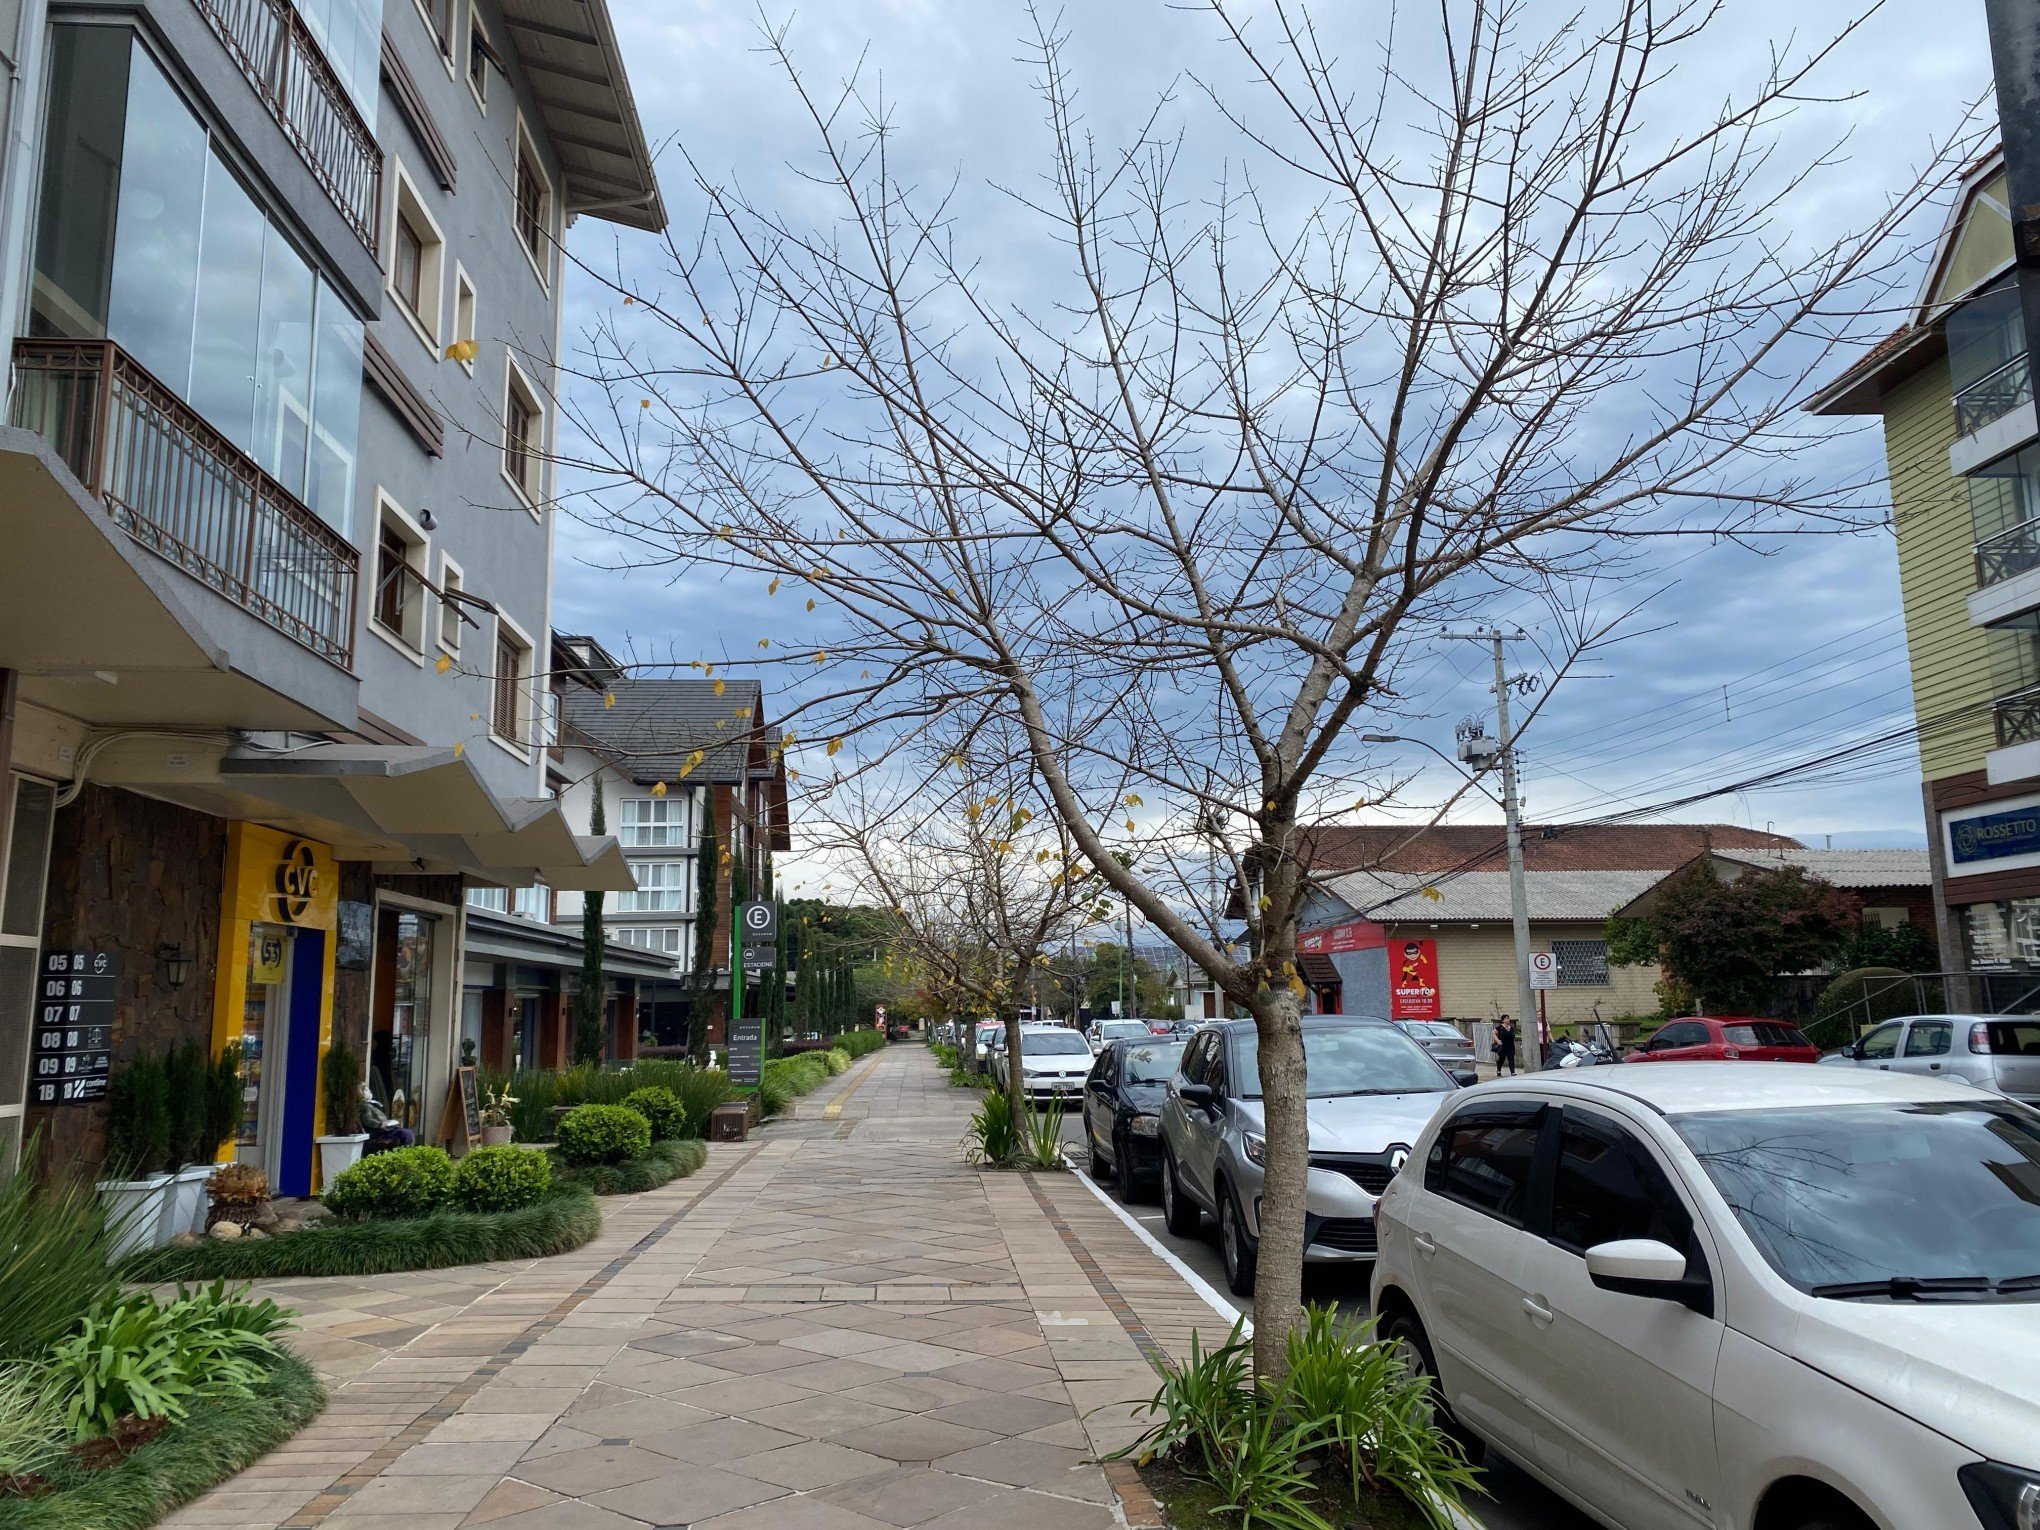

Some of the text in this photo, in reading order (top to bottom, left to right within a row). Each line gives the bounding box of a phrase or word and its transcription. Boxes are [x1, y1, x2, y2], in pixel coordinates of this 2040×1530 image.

[1976, 819, 2036, 839] ROSSETTO
[284, 864, 318, 898] CVC
[753, 910, 763, 924] E
[48, 954, 68, 971] 05
[73, 954, 108, 970] 05 CVC
[1540, 957, 1546, 967] E
[46, 980, 66, 997] 06
[71, 979, 82, 996] 06
[1395, 987, 1436, 996] SUPER TOP
[44, 1006, 64, 1022] 07
[69, 1005, 80, 1021] 07
[41, 1032, 61, 1048] 08
[67, 1031, 78, 1047] 08
[39, 1058, 59, 1074] 09
[64, 1056, 76, 1073] 09
[38, 1084, 55, 1101] 1B
